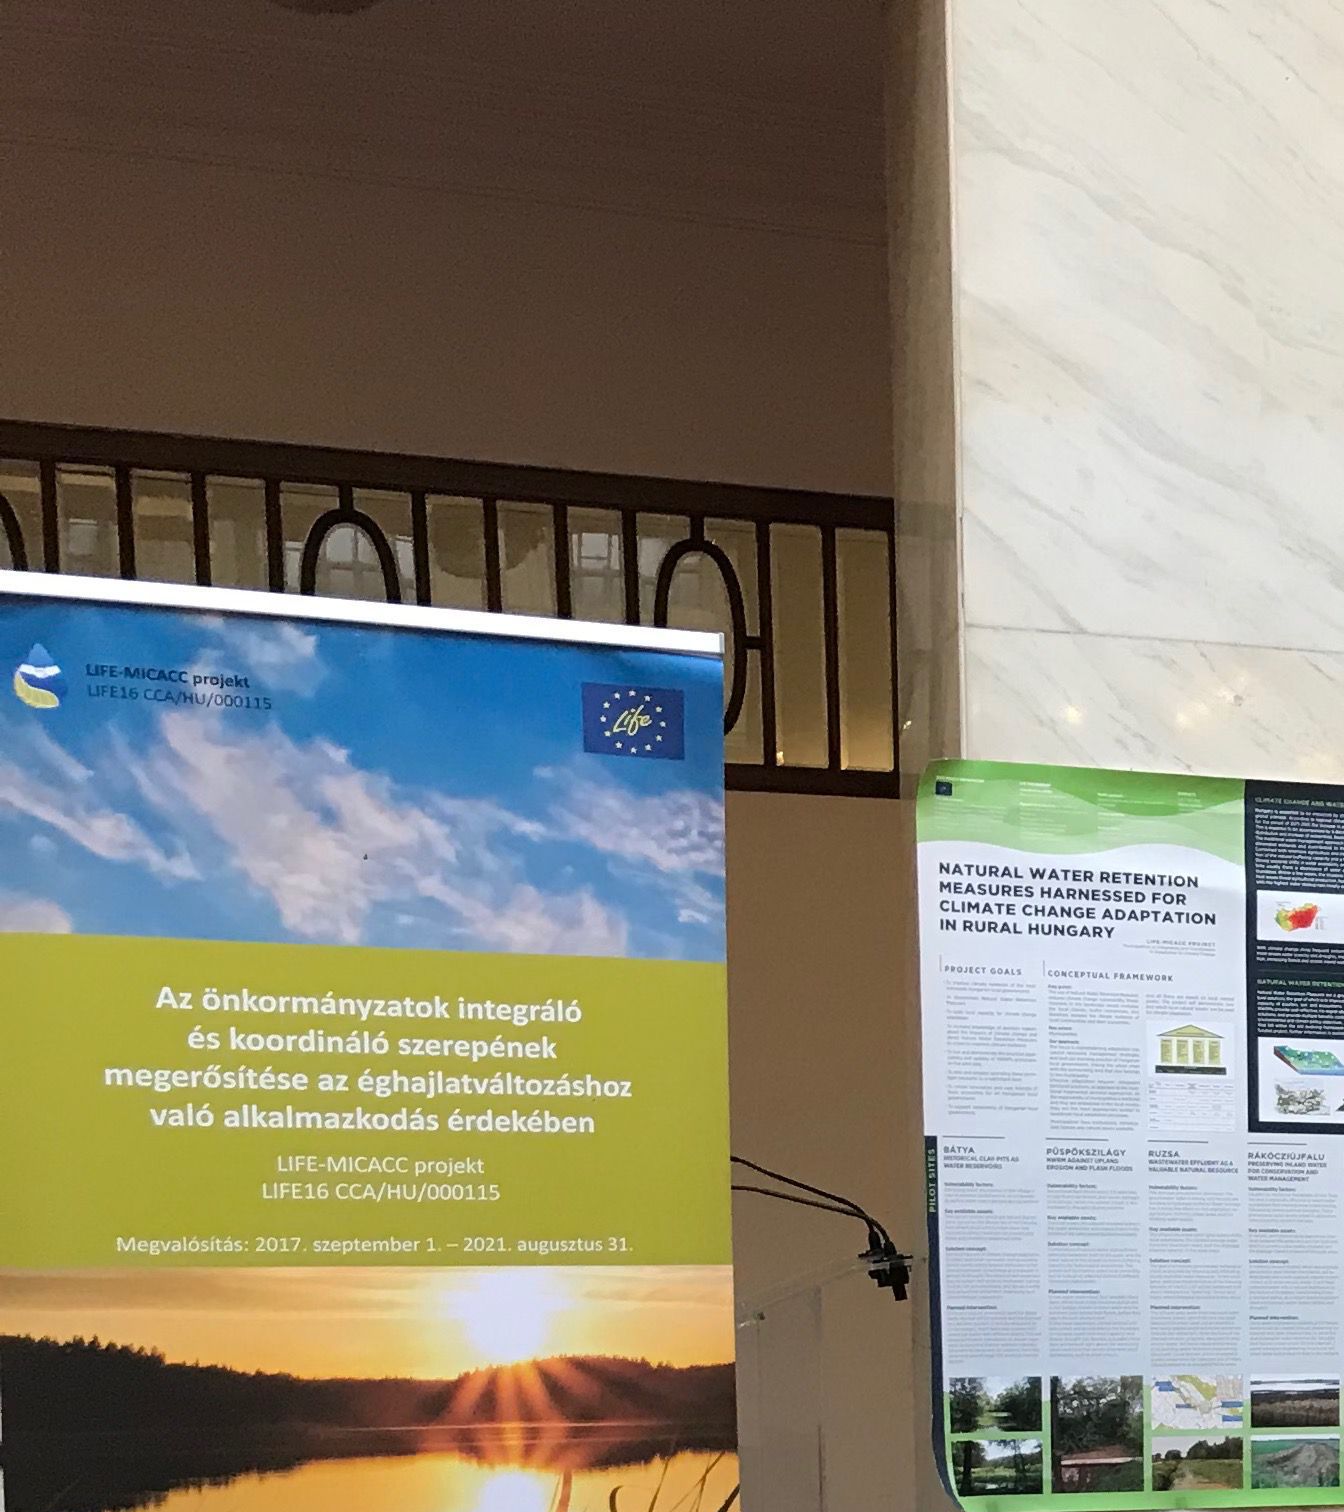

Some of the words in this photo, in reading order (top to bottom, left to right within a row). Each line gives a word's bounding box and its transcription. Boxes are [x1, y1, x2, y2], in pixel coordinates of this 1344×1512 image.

[86, 663, 188, 684] LIFE-MICACC
[193, 674, 250, 689] projekt
[88, 685, 138, 700] LIFE16
[144, 690, 272, 711] CCA/HU/000115
[613, 704, 652, 736] Life
[940, 863, 1023, 879] NATURAL
[1030, 868, 1093, 882] WATER
[1100, 871, 1198, 888] RETENTION
[940, 882, 1034, 897] MEASURES
[1041, 887, 1145, 903] HARNESSED
[1152, 892, 1186, 905] FOR
[940, 900, 1015, 916] CLIMATE
[1022, 904, 1095, 919] CHANGE
[1102, 908, 1215, 925] ADAPTATION
[941, 919, 956, 931] IN
[963, 920, 1022, 935] RURAL
[1029, 923, 1114, 938] HUNGARY
[945, 966, 986, 975] PROJECT
[990, 967, 1021, 975] GOALS
[1048, 970, 1109, 979] CONCEPTUAL
[1114, 972, 1173, 982] FRAMEWORK
[156, 987, 192, 1010] Az
[203, 988, 450, 1019] önkormányzatok
[458, 998, 581, 1026] integráló
[188, 1025, 220, 1049] és
[230, 1028, 389, 1054] koordináló
[398, 1036, 557, 1061] szerepének
[105, 1065, 308, 1092] megerősítése
[318, 1074, 348, 1092] az
[358, 1070, 632, 1097] éghajlatváltozáshoz
[150, 1103, 214, 1126] való
[224, 1105, 439, 1131] alkalmazkodás
[448, 1109, 594, 1133] érdekében
[944, 1145, 975, 1154] BÁTYA
[1047, 1147, 1126, 1158] PÜSPÖKSZILÁGY
[1148, 1150, 1180, 1158] RUZSA
[1248, 1152, 1326, 1161] RÁKÓCZIÚJFALU
[278, 1156, 408, 1173] LIFE-MICACC
[415, 1157, 484, 1177] projekt
[927, 1149, 936, 1179] SITES
[263, 1183, 329, 1199] LIFE16
[336, 1183, 500, 1202] CCA/HU/000115
[928, 1183, 936, 1213] PILOT
[117, 1237, 248, 1256] Megvalósítás:
[256, 1237, 306, 1252] 2017.
[313, 1237, 420, 1254] szeptember
[427, 1237, 441, 1252] 1.
[464, 1237, 511, 1251] 2021.
[518, 1238, 602, 1255] augusztus
[609, 1236, 632, 1251] 31.
